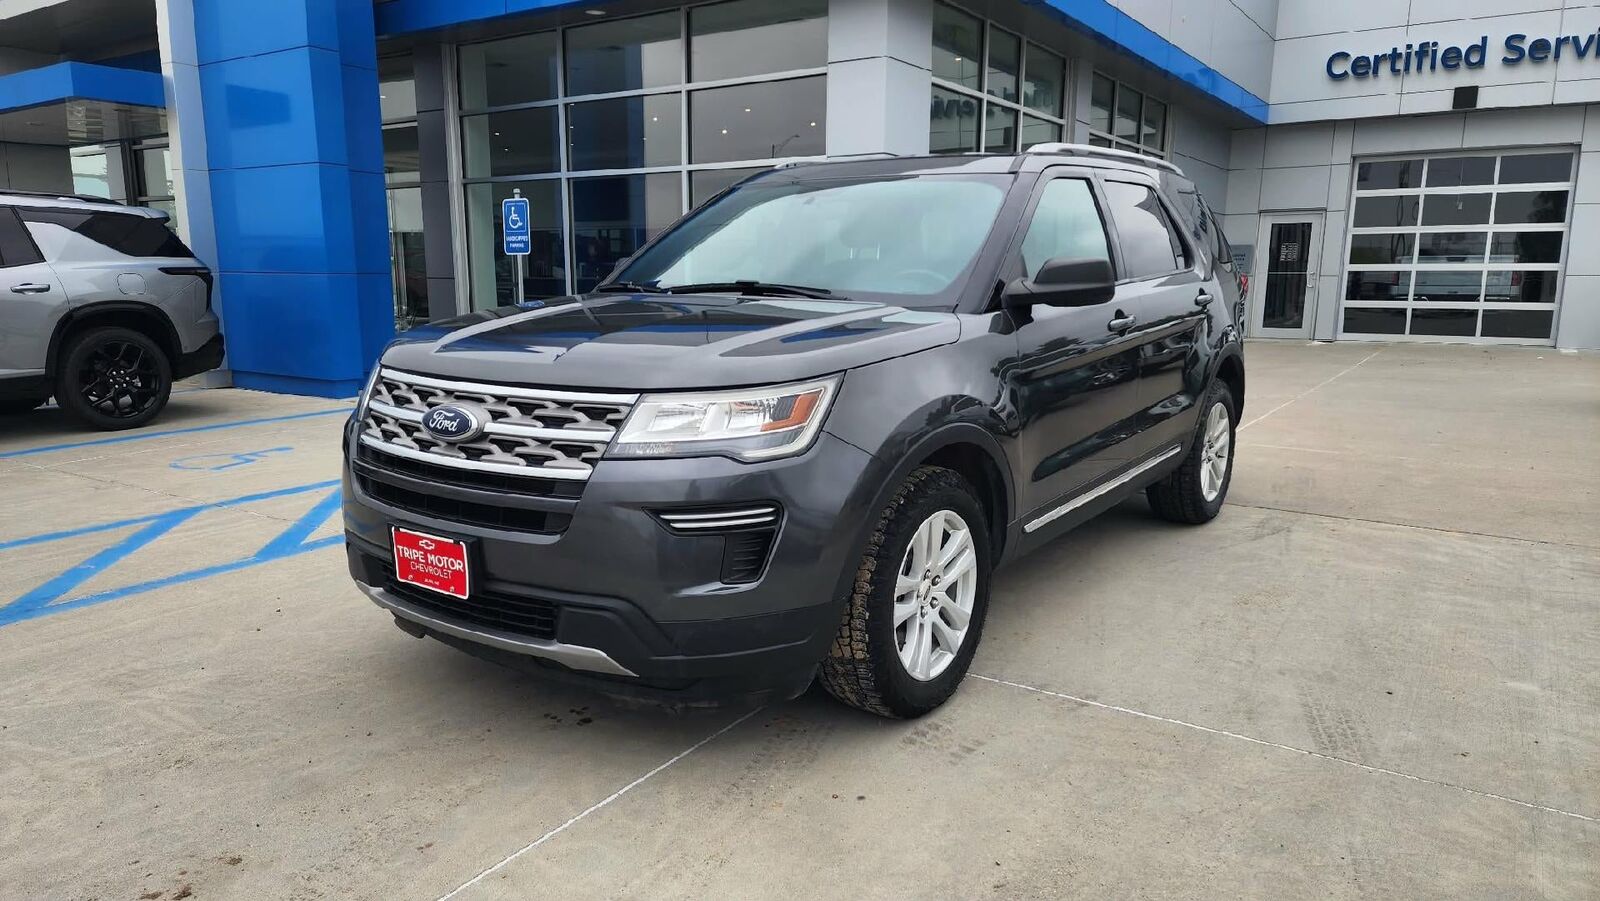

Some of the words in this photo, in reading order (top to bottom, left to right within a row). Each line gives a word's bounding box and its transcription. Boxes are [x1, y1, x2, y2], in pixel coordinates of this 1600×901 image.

[1326, 35, 1489, 79] Certified
[429, 409, 460, 432] Ford
[397, 545, 425, 563] TRIPE
[427, 553, 464, 573] MOTOR
[410, 561, 452, 579] CHEVROLET
